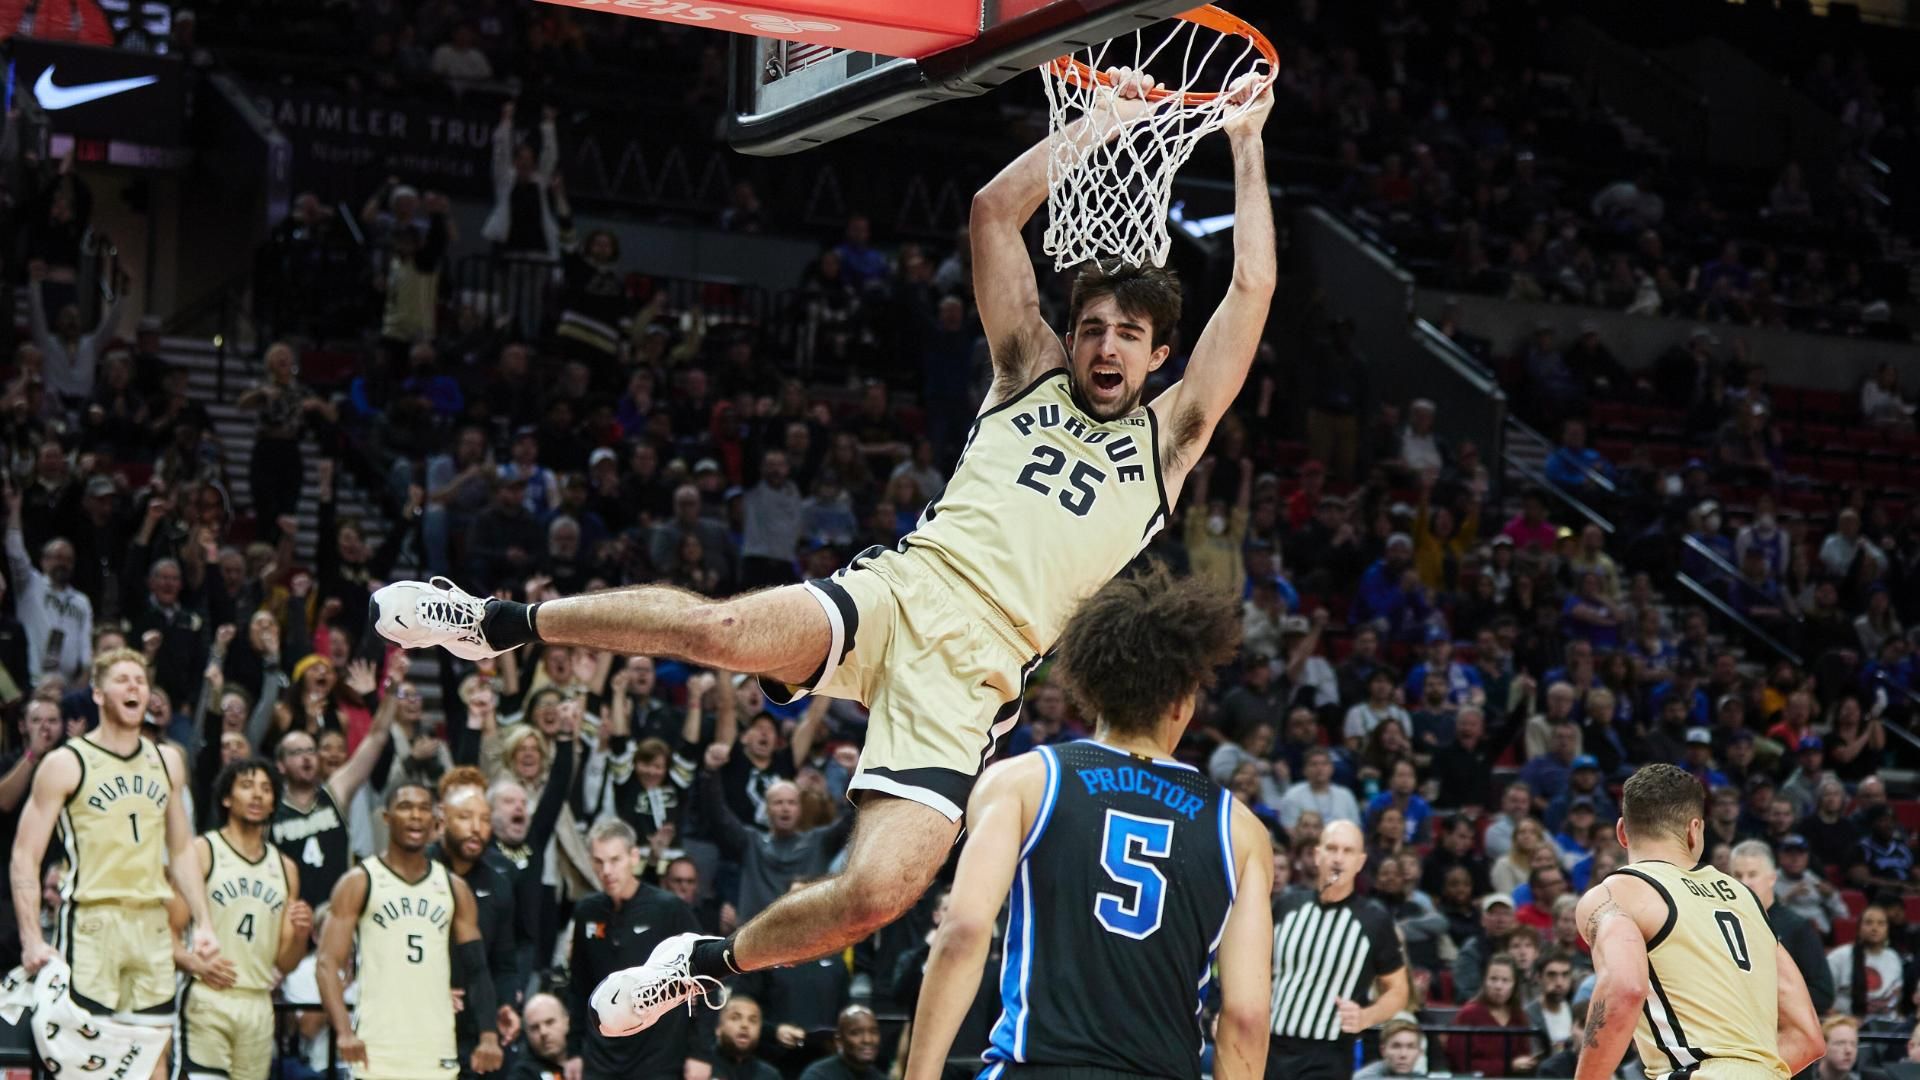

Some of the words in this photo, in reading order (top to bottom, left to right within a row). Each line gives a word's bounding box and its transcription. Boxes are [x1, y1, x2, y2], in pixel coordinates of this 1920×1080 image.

[427, 114, 531, 149] TRUK
[1010, 404, 1145, 484] PURDUE
[1015, 444, 1107, 517] 25
[88, 775, 167, 812] PURDUE
[1076, 766, 1205, 821] PROCTOR
[129, 813, 139, 843] 1
[302, 835, 325, 868] 4
[1094, 808, 1174, 940] 5
[212, 877, 283, 913] PURDUE
[237, 913, 254, 942] 4
[1713, 908, 1752, 974] 0
[407, 934, 424, 964] 5
